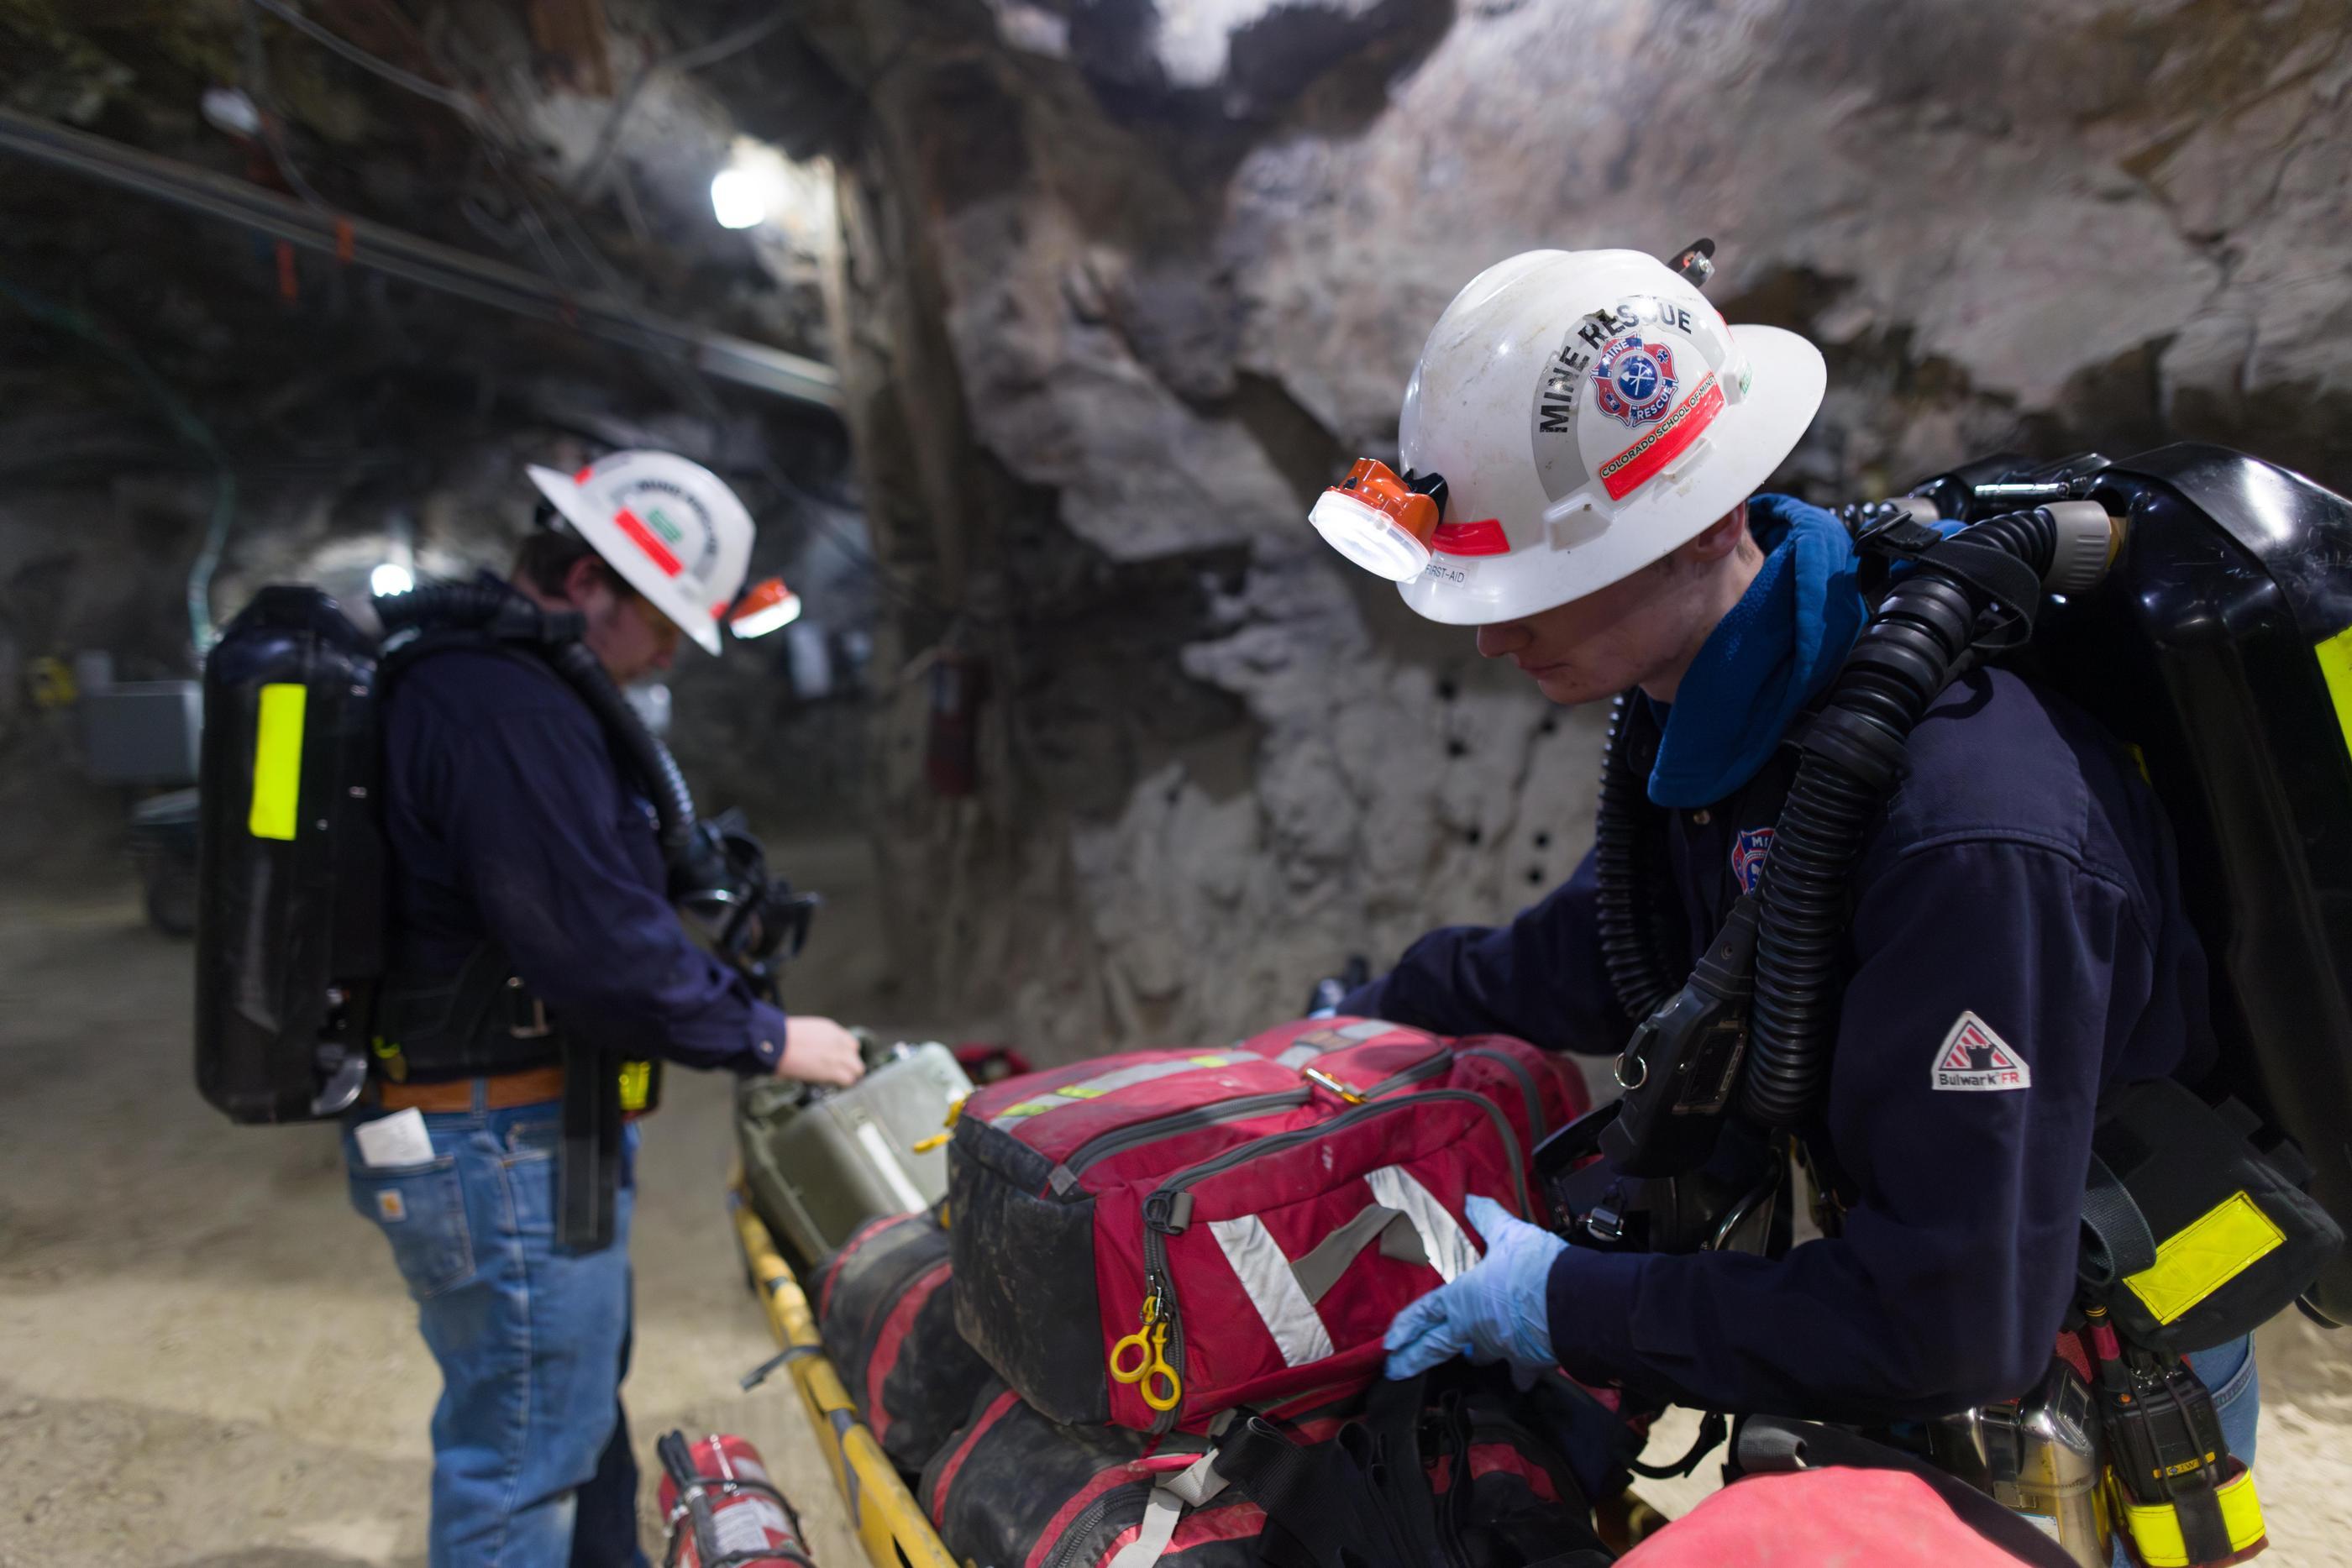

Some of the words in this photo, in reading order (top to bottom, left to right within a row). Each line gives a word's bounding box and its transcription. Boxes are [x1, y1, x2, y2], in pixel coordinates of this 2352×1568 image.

[1602, 340, 1630, 364] MINE
[1540, 345, 1590, 433] MINE
[1636, 385, 1673, 420] RESCUE
[1601, 434, 1656, 477] COLORADO
[1656, 406, 1690, 437] SCHOOL
[1689, 394, 1699, 406] OF
[1425, 564, 1465, 583] FIRST-AID
[1751, 836, 1768, 847] MI
[1939, 1073, 1997, 1086] Bulwark
[2002, 1072, 2019, 1083] FR
